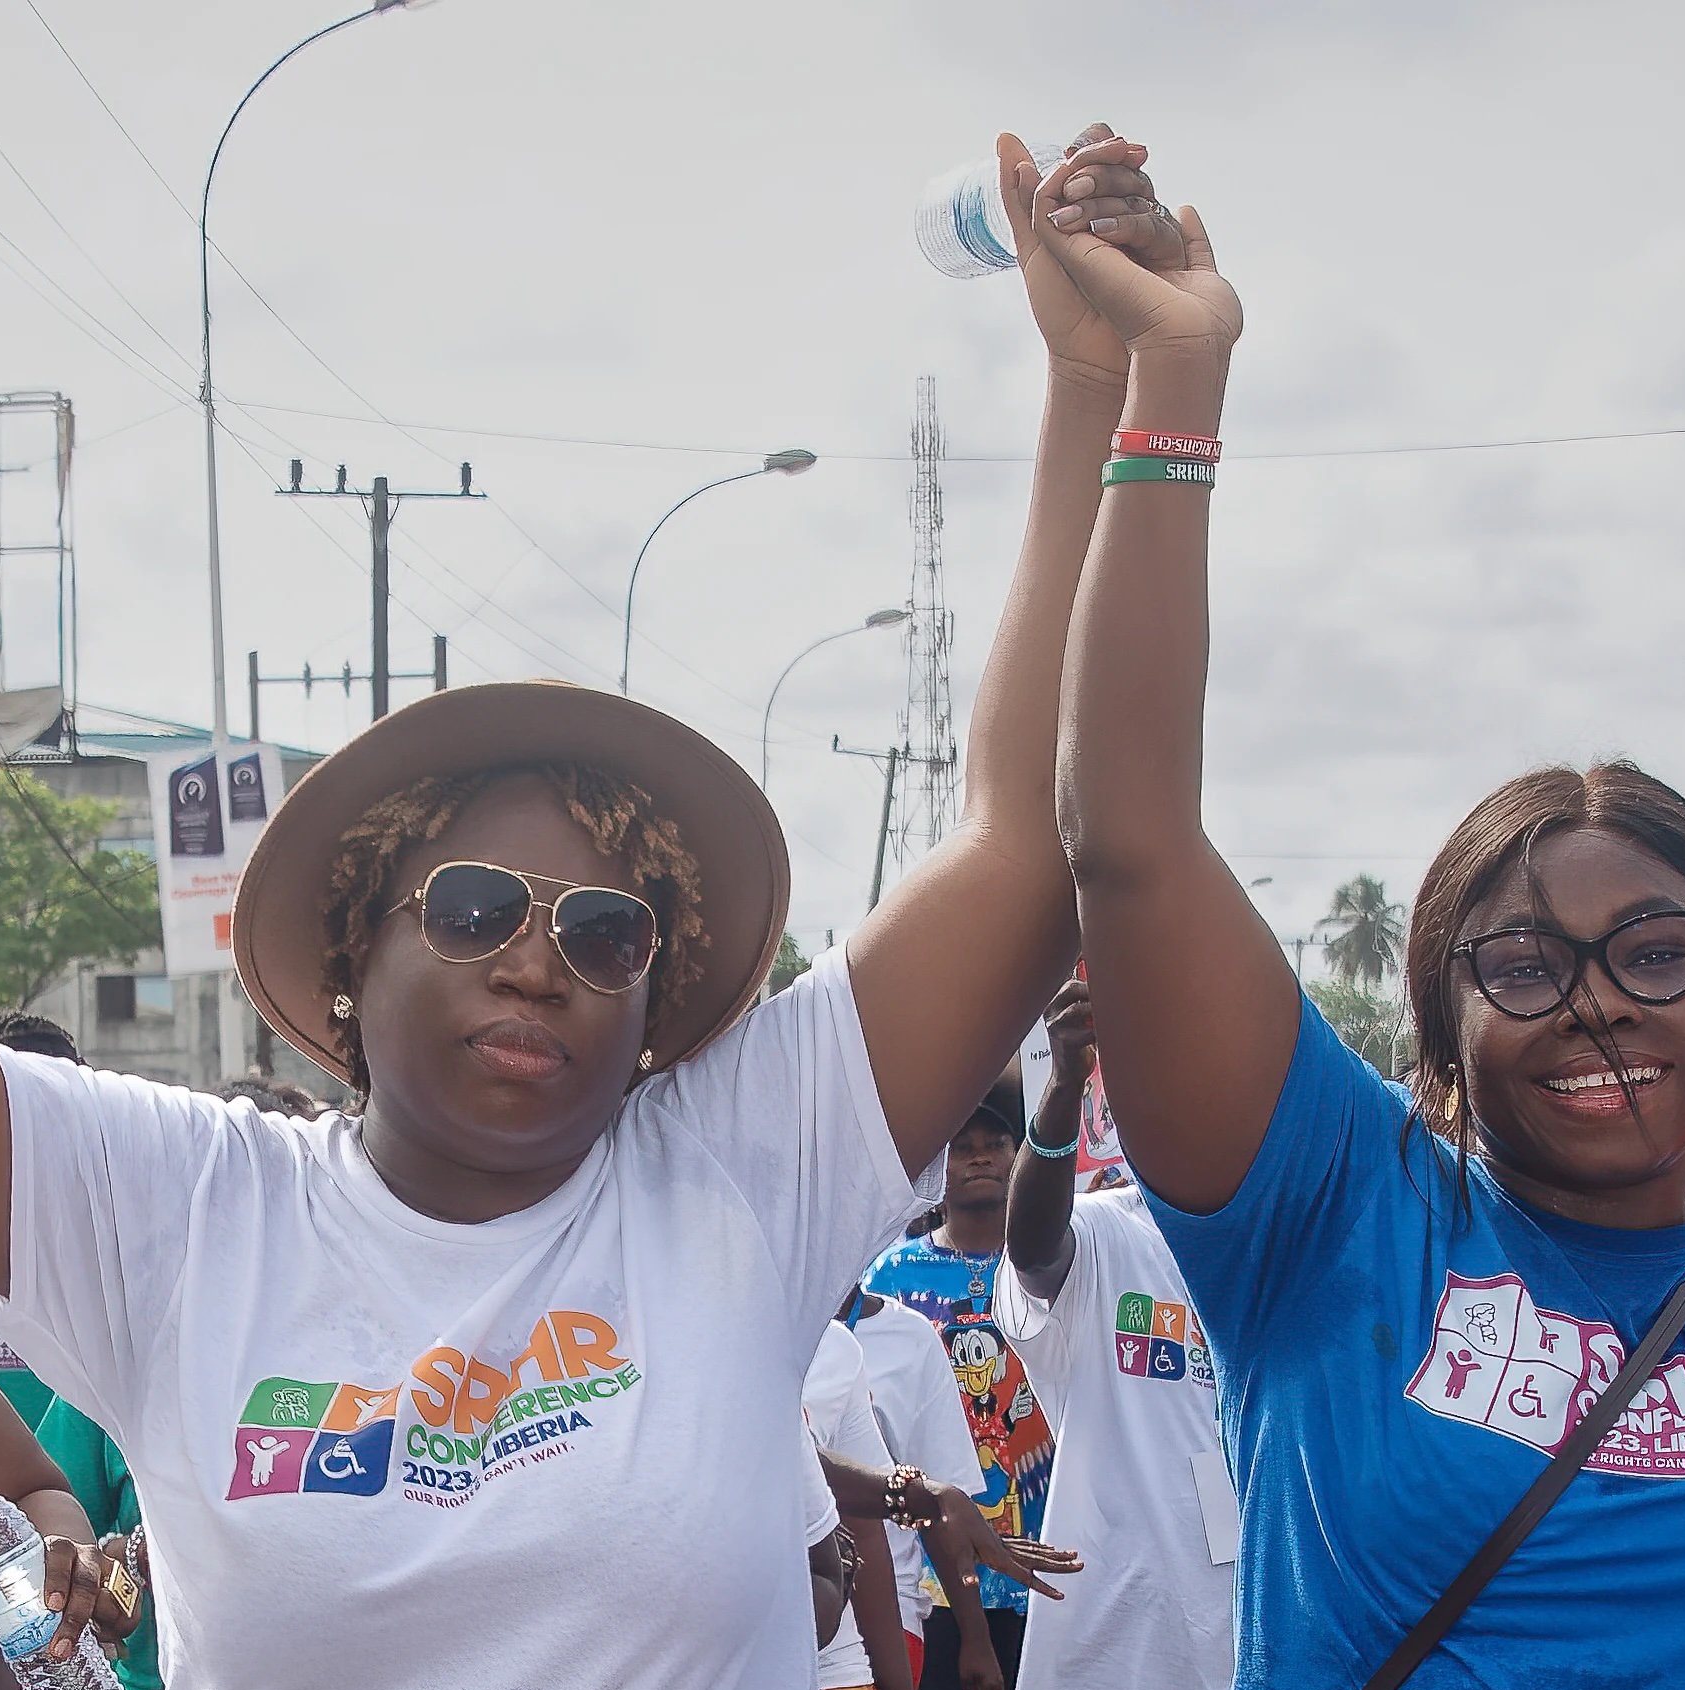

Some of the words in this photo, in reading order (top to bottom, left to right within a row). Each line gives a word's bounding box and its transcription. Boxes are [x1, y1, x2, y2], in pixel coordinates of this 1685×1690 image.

[411, 1310, 630, 1434] SRHR
[481, 1410, 593, 1470] LIBERIA
[1599, 1453, 1652, 1469] RIGHTS
[403, 1488, 434, 1506] OUR
[483, 1456, 527, 1483] CAN'T
